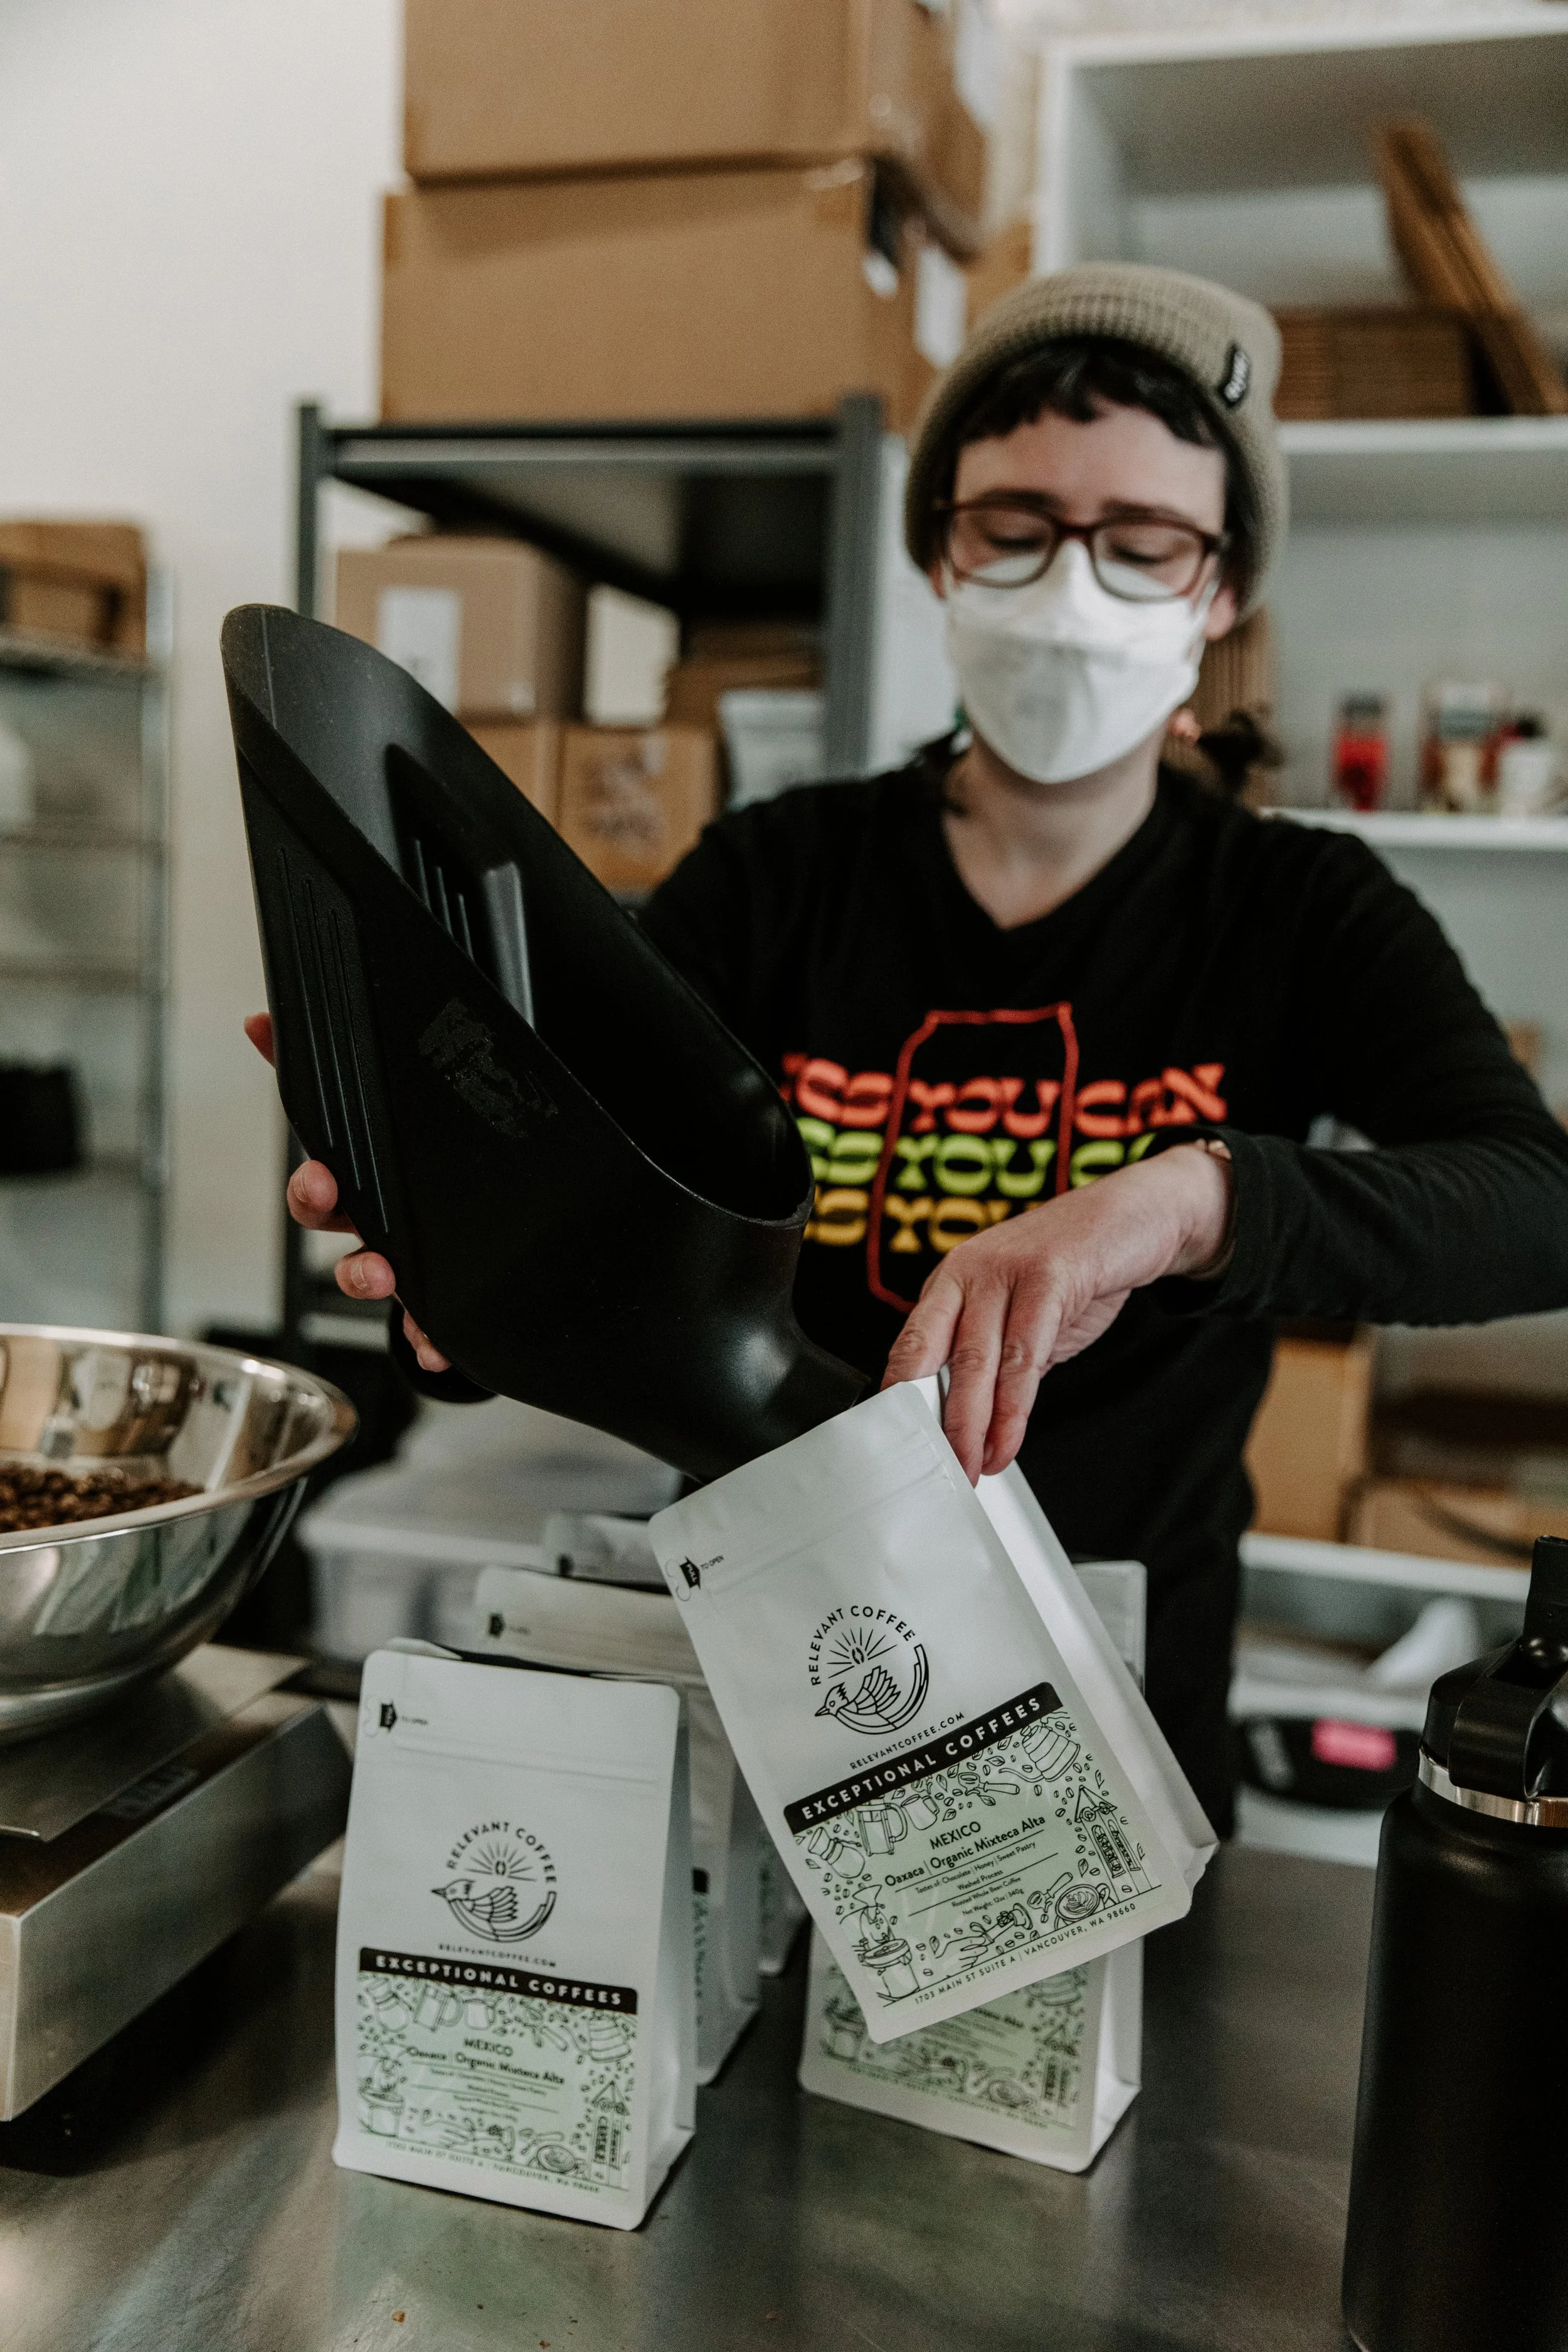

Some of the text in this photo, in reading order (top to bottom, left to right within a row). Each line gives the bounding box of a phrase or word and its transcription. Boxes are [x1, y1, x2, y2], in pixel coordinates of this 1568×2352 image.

[908, 1076, 1062, 1138] YOU
[1074, 1062, 1227, 1138] CAN
[895, 1134, 1057, 1197] YOU
[809, 1606, 916, 1686] RELEVANT COFFEE
[802, 1697, 1041, 1820] EXCEPTIONAL COFFEES
[849, 1712, 965, 1770] RELEVANTCOFFEE.COM
[446, 1821, 557, 1883] RELEVANT COFFEE
[885, 1816, 1046, 1886] Oaxaca Organic Mixteca Alta
[930, 1821, 981, 1850] MEXICO
[915, 1884, 934, 1894] Tastes
[942, 1870, 972, 1884] Chocolate
[974, 1860, 994, 1872] Honey
[997, 1850, 1016, 1862] Sweet
[1015, 1841, 1036, 1853] Pastry
[951, 1896, 972, 1907] Roasted
[972, 1890, 990, 1900] Whole
[1003, 1877, 1021, 1887] Coffee
[957, 1870, 1004, 1890] Washed Process
[1008, 1888, 1025, 1898] 340g
[376, 1955, 622, 2005] EXCEPTIONAL COFFEES
[915, 1991, 935, 2004] 1703
[939, 1979, 963, 1994] MAIN
[966, 1972, 976, 1983] ST
[980, 1961, 1007, 1976] SUITE
[1024, 1926, 1088, 1956] VANCOUVER,
[1090, 1917, 1105, 1927] WA
[1107, 1903, 1136, 1920] 98660
